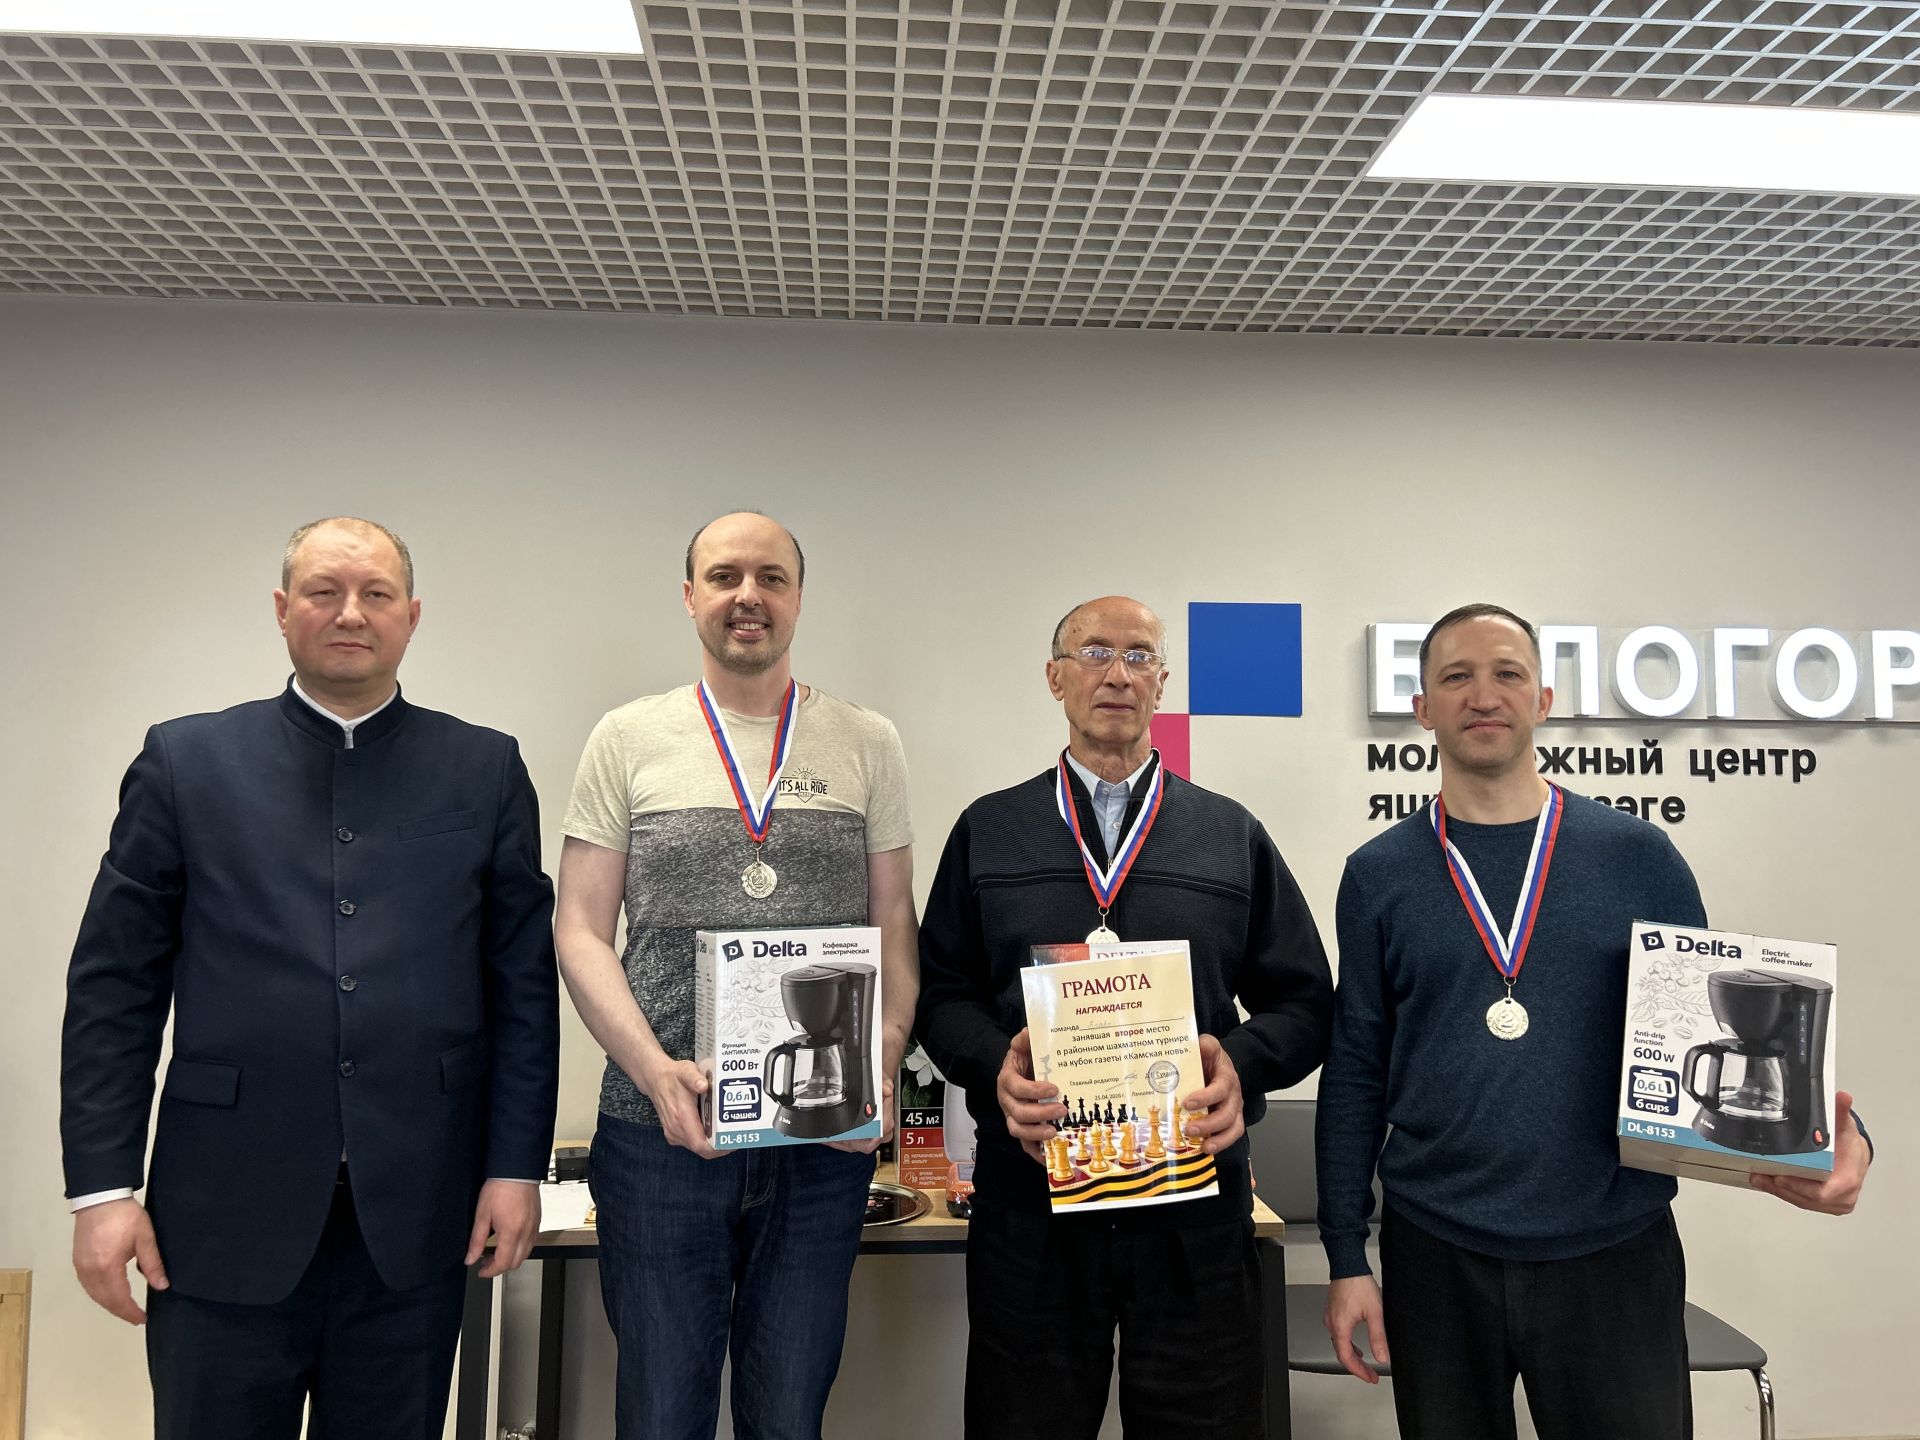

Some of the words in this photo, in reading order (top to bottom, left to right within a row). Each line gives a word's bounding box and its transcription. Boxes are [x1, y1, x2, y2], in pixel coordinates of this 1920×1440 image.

[1373, 622, 1920, 719] БЛОГОР
[1690, 748, 1817, 783] центр
[795, 781, 808, 792] ALL
[752, 940, 807, 958] Delta
[822, 948, 869, 956] электрическая
[1675, 935, 1742, 959] Delta
[1761, 949, 1791, 959] Electric
[1761, 956, 1786, 965] coffee
[1787, 959, 1813, 968] maker
[1061, 973, 1152, 999] ГРАМОТА
[1075, 1001, 1143, 1016] НАГРАЖДАЕТСЯ
[1050, 1025, 1080, 1033] команда
[1072, 1032, 1111, 1042] занявшая
[1114, 1028, 1144, 1039] второе
[1146, 1025, 1170, 1034] место
[1634, 1030, 1666, 1040] Anti-drip
[1063, 1045, 1105, 1057] районном
[1106, 1040, 1154, 1051] шахматном
[1155, 1035, 1189, 1046] турнире
[1633, 1037, 1663, 1047] function
[1058, 1060, 1068, 1068] на
[1069, 1055, 1093, 1067] кубок
[1095, 1055, 1122, 1064] газеты
[1124, 1050, 1163, 1060] «Камская
[1633, 1047, 1662, 1061] 600
[1663, 1054, 1675, 1063] W
[722, 1060, 746, 1071] 600
[748, 1061, 759, 1070] Вт
[1093, 1077, 1120, 1085] редактор
[1637, 1079, 1657, 1091] 0,6
[1658, 1083, 1664, 1093] L
[726, 1091, 743, 1102] 0,6
[743, 1093, 750, 1101] л
[1635, 1099, 1644, 1109] 6
[1645, 1102, 1670, 1114] cups
[723, 1111, 730, 1120] 6
[731, 1112, 757, 1120] чашек
[905, 1112, 923, 1125] 45
[1627, 1122, 1676, 1139] DL-8153
[720, 1133, 760, 1145] DL-8153
[905, 1132, 914, 1145] 5
[917, 1136, 924, 1145] л
